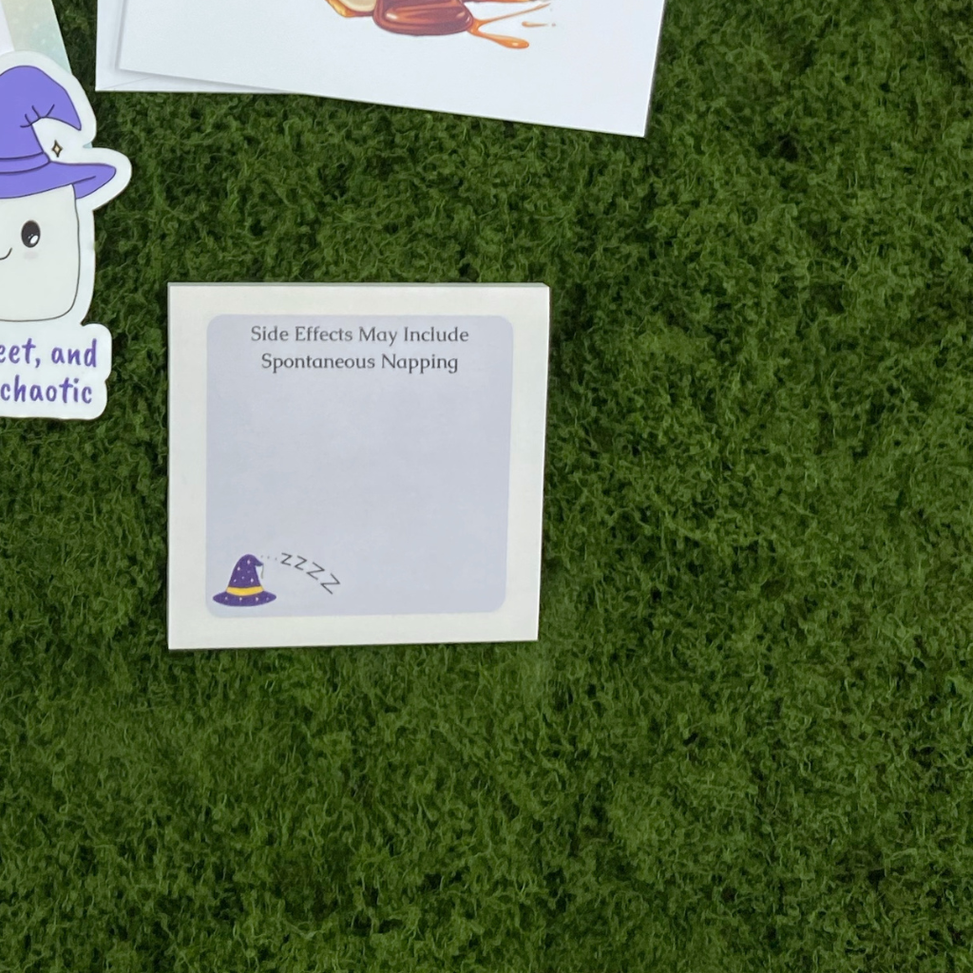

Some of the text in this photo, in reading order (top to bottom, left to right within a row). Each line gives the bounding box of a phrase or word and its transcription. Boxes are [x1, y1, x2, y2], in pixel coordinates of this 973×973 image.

[250, 325, 470, 347] Side Effects May Include
[50, 338, 98, 369] and
[260, 352, 459, 374] Spontaneous Napping
[0, 373, 94, 405] chaotic
